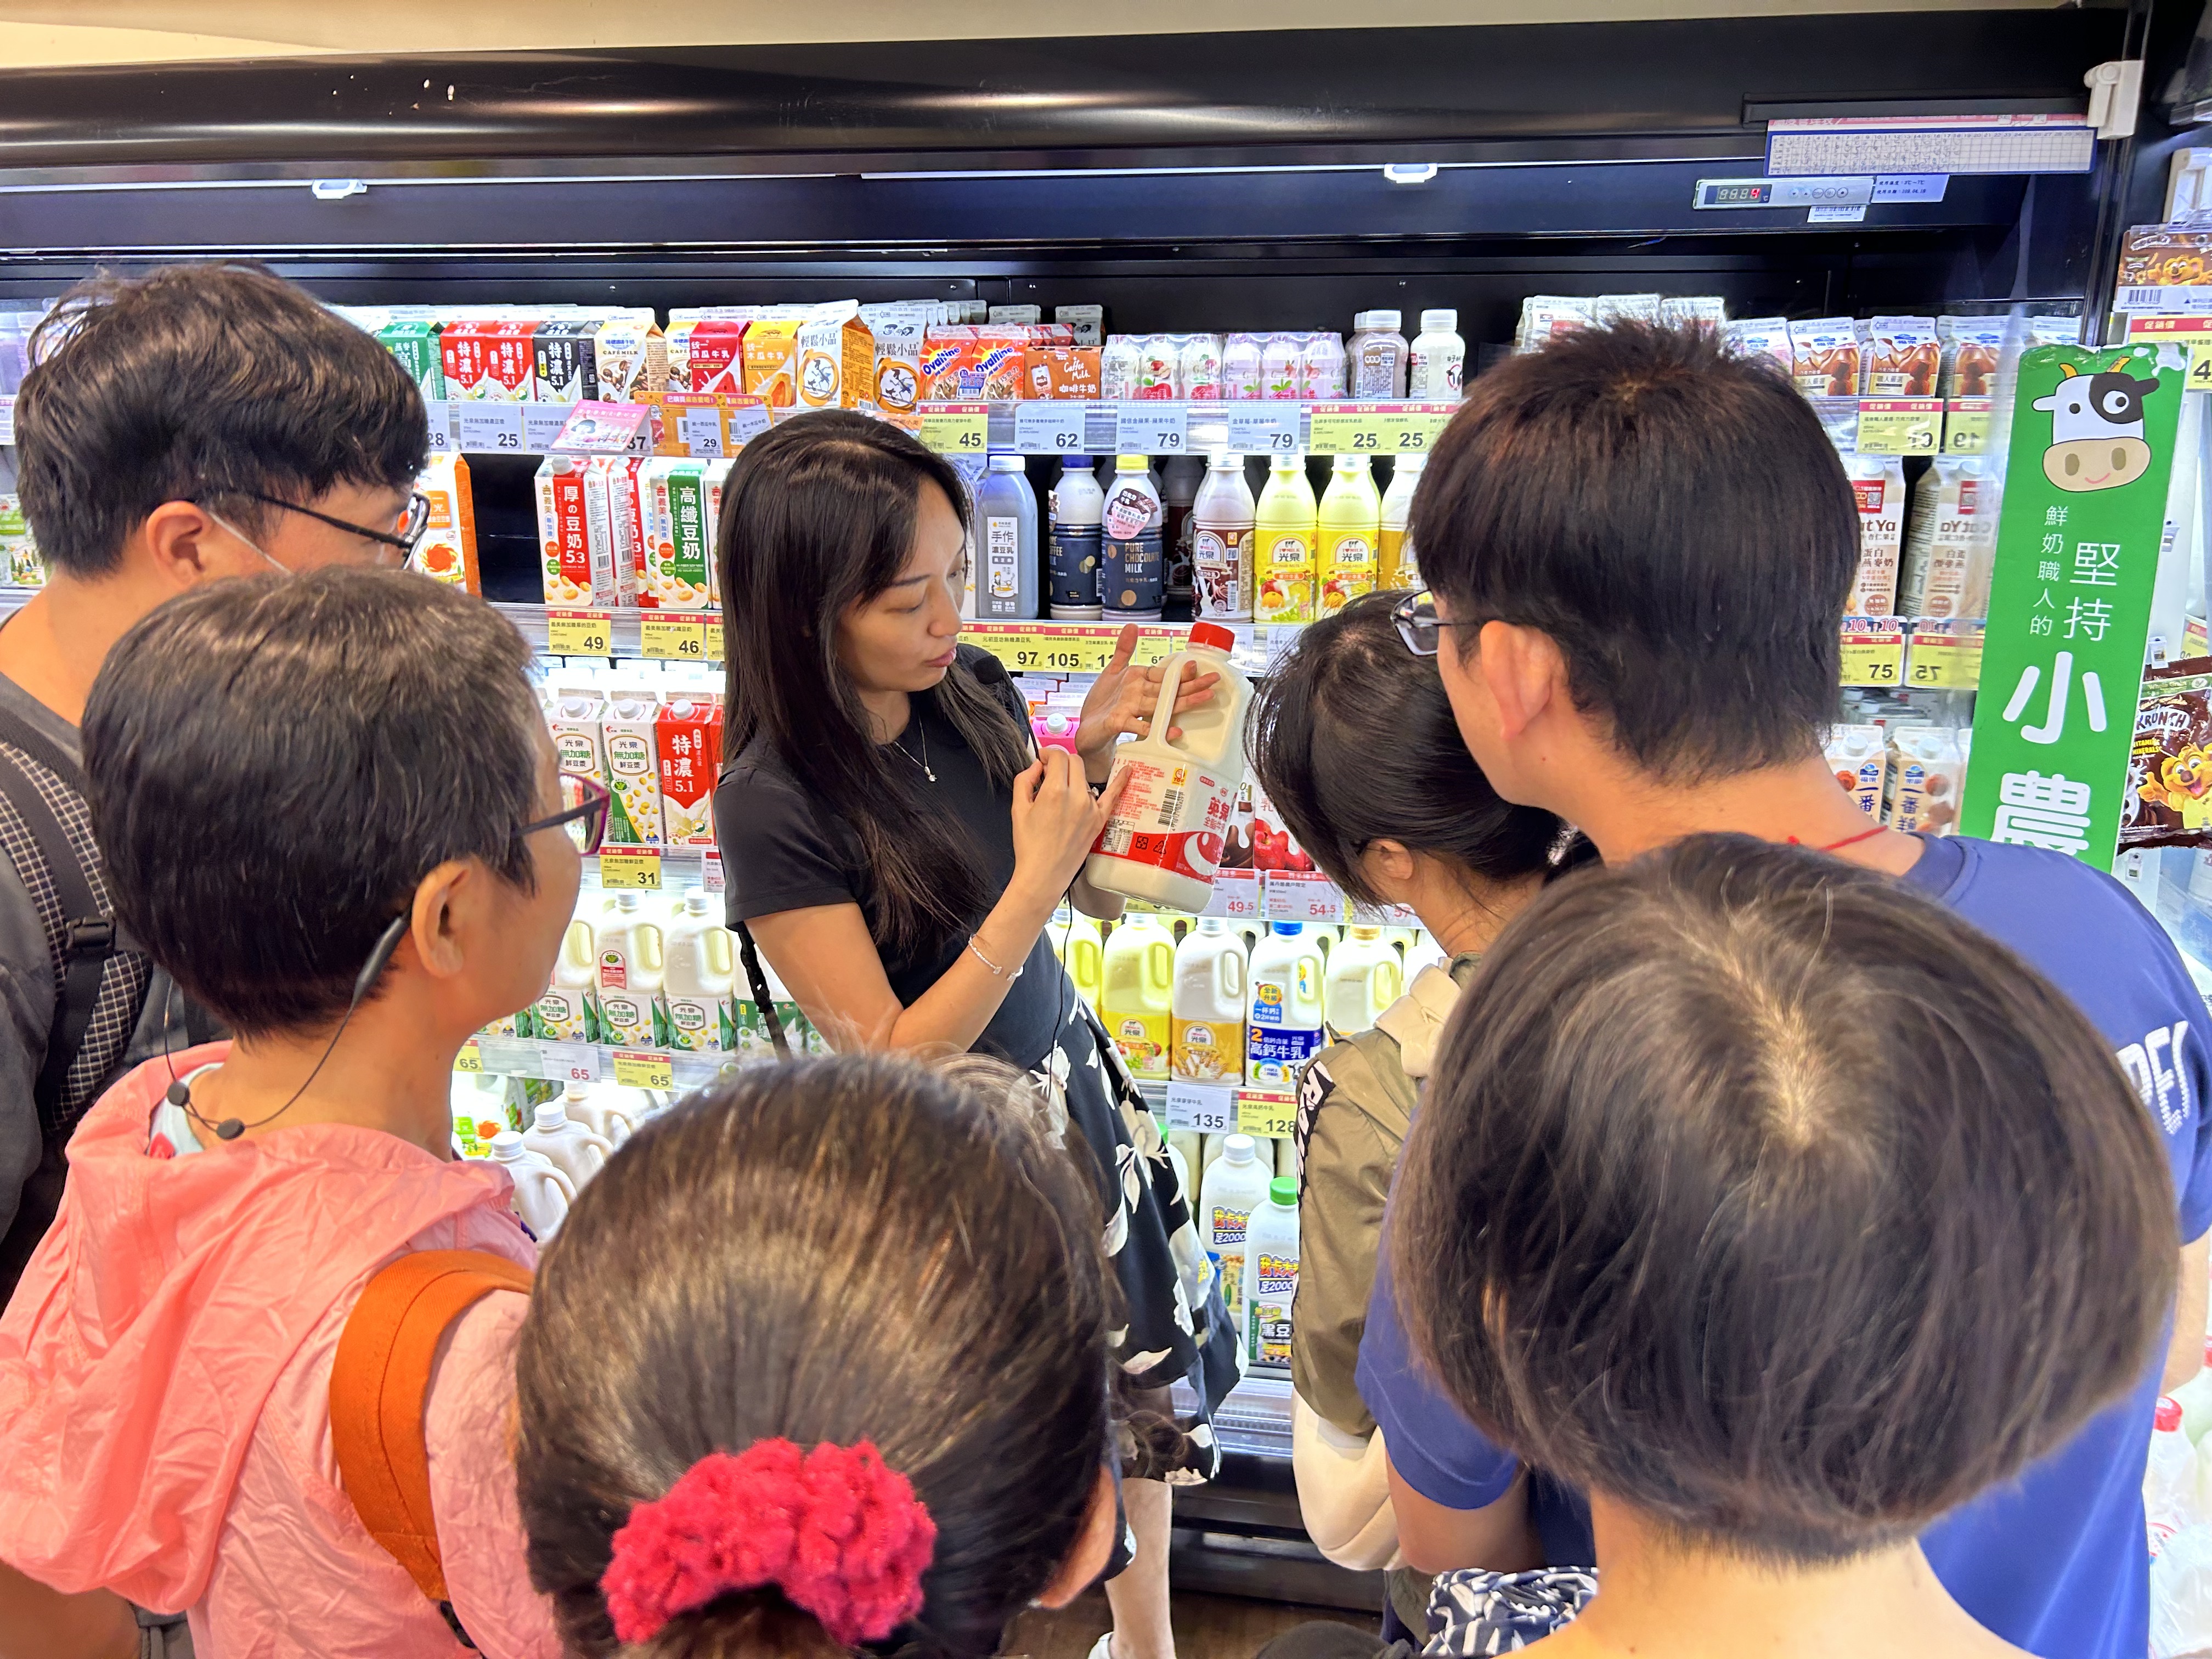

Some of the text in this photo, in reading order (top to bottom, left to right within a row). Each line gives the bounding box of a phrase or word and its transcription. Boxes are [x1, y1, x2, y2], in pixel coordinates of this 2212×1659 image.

[800, 332, 837, 348] 輕鬆小品
[691, 349, 730, 359] 西瓜牛乳
[875, 342, 918, 357] 輕鬆小品
[458, 341, 474, 374] 特濃
[500, 342, 516, 375] 特濃
[549, 342, 565, 375] 特濃
[747, 352, 785, 361] 木瓜牛乳
[922, 347, 962, 376] Ovaltine
[975, 347, 1014, 374] Ovaltine
[1063, 359, 1085, 374] Coffee
[460, 374, 473, 384] 5.1
[503, 375, 516, 385] 5.1
[551, 375, 565, 386] 5.1
[1000, 366, 1019, 383] 巧克力
[1071, 370, 1091, 381] Milk
[1059, 384, 1097, 394] 咖啡牛奶
[498, 433, 518, 447] 25
[703, 439, 717, 447] 29
[960, 432, 981, 447] 45
[1056, 433, 1078, 447] 62
[1157, 433, 1180, 447] 79
[1270, 433, 1293, 448] 79
[1353, 433, 1377, 448] 25
[1400, 432, 1423, 447] 25
[564, 486, 585, 563] 厚の豆奶 5.3
[680, 486, 701, 560] 高纖豆奶
[991, 531, 1014, 543] 手作
[1125, 542, 1144, 552] PURE
[1863, 549, 1883, 557] 蛋白
[1125, 551, 1160, 563] CHOCOLATE
[1199, 550, 1215, 560] 光泉
[1279, 553, 1300, 562] 光泉
[1342, 553, 1363, 562] 光泉
[1125, 563, 1143, 573] MILK
[1861, 558, 1893, 567] 燕麥奶
[2029, 504, 2068, 637] 鮮奶職人的
[2063, 541, 2119, 642] 堅持
[1848, 619, 1866, 631] 10
[1880, 618, 1898, 631] 10
[584, 636, 604, 649] 49
[679, 640, 699, 653] 46
[1017, 651, 1039, 665] 97
[1047, 653, 1079, 667] 105
[1869, 664, 1893, 679] 75
[2136, 712, 2187, 731] KRUNCH
[560, 749, 591, 759] 無加糖
[614, 751, 645, 760] 無加糖
[672, 734, 695, 778] 特濃
[1989, 651, 2107, 856] 小農
[675, 780, 694, 793] 5.1
[1855, 786, 1879, 813] 一番
[637, 872, 655, 884] 31
[1227, 901, 1254, 913] 49.5
[1310, 904, 1336, 916] 54.5
[540, 1005, 566, 1013] 無加糖
[608, 1009, 635, 1018] 無加糖
[675, 1013, 702, 1022] 無加糖
[1251, 1028, 1263, 1042] 2
[1250, 1042, 1305, 1059] 高鈣牛乳
[459, 1058, 478, 1069] 65
[571, 1068, 590, 1080] 65
[650, 1075, 669, 1086] 65
[1193, 1113, 1224, 1128] 135
[1215, 1232, 1246, 1244] 足2000
[1262, 1323, 1291, 1337] 黑豆
